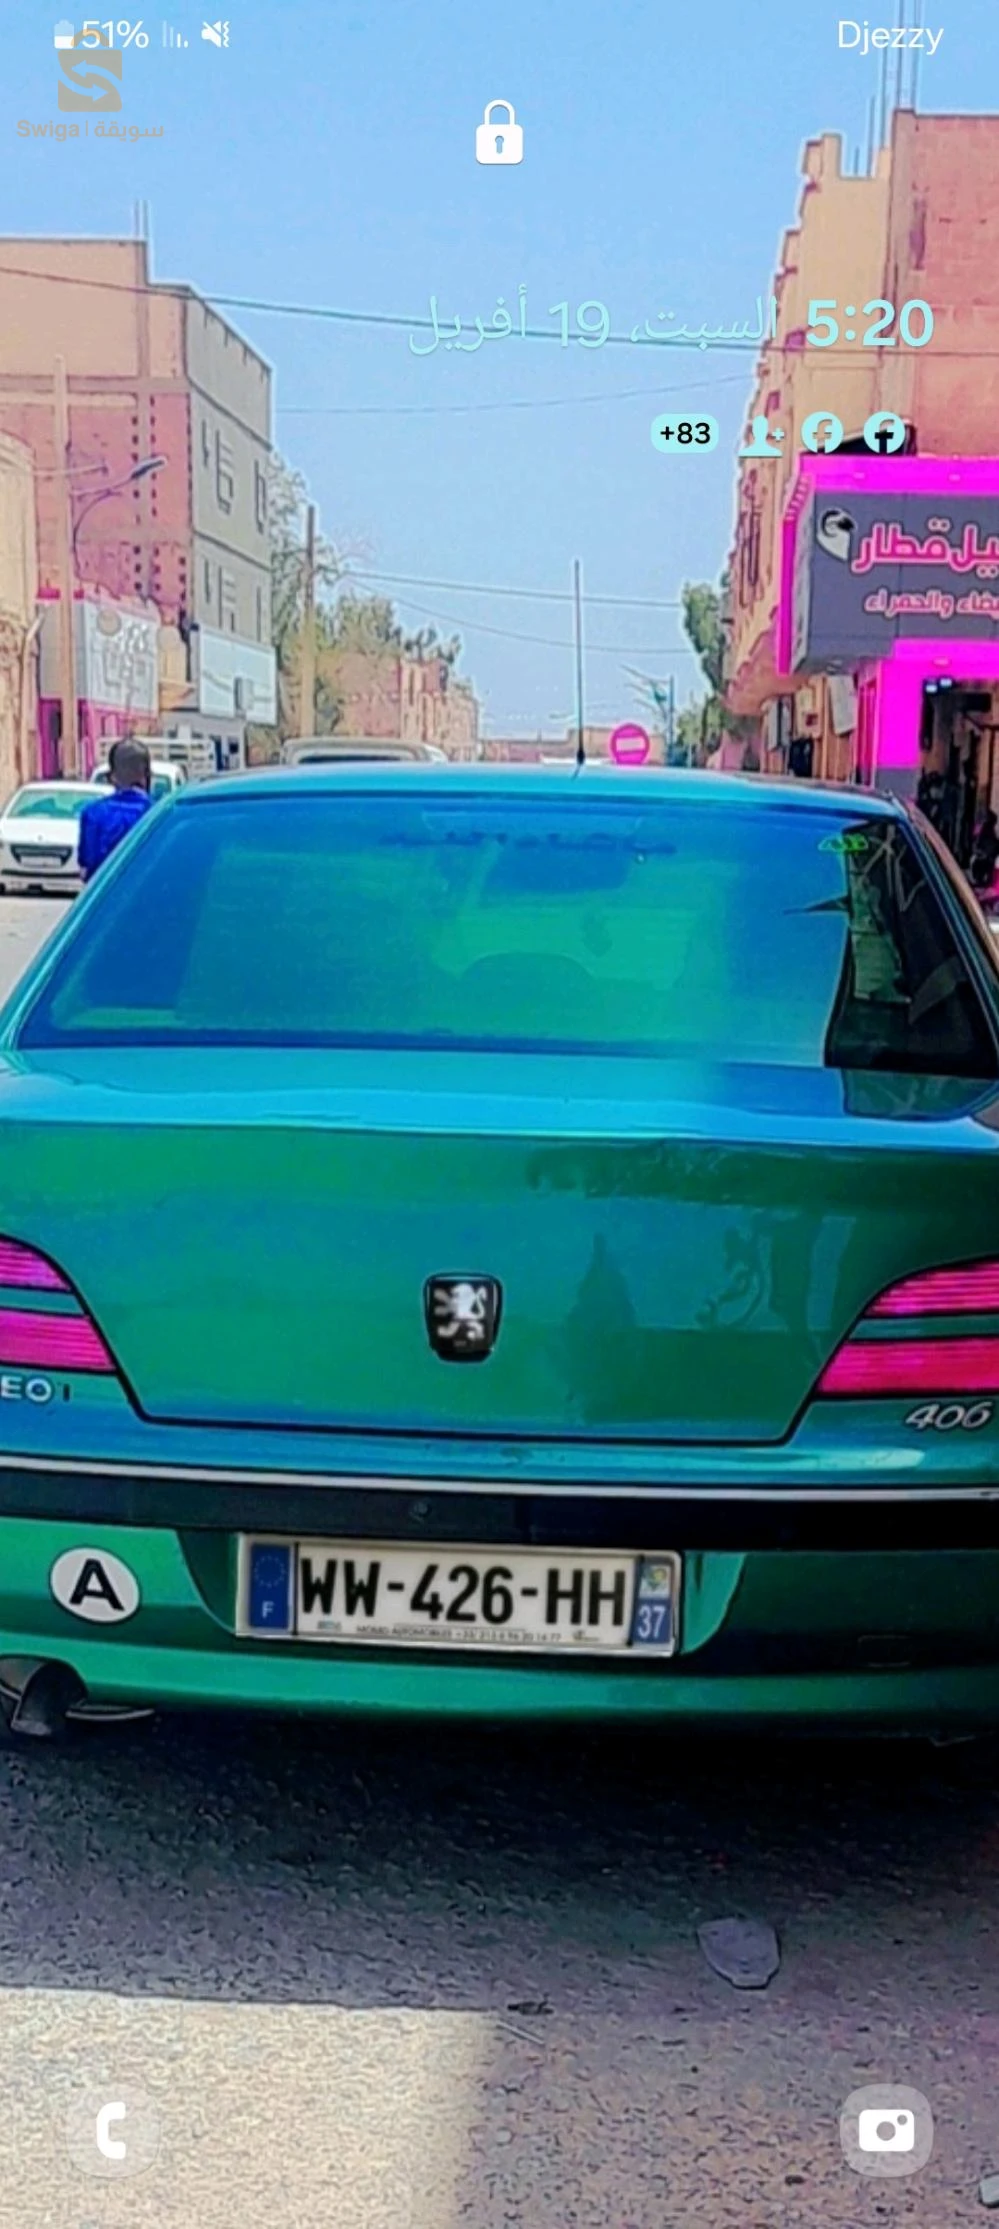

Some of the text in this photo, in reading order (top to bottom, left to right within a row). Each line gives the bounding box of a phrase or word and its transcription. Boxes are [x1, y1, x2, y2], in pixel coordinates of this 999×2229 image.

[905, 1401, 993, 1430] 406
[68, 1558, 125, 1611] A
[301, 1557, 627, 1627] WW-426-HH
[261, 1601, 275, 1618] F
[638, 1604, 667, 1639] 37
